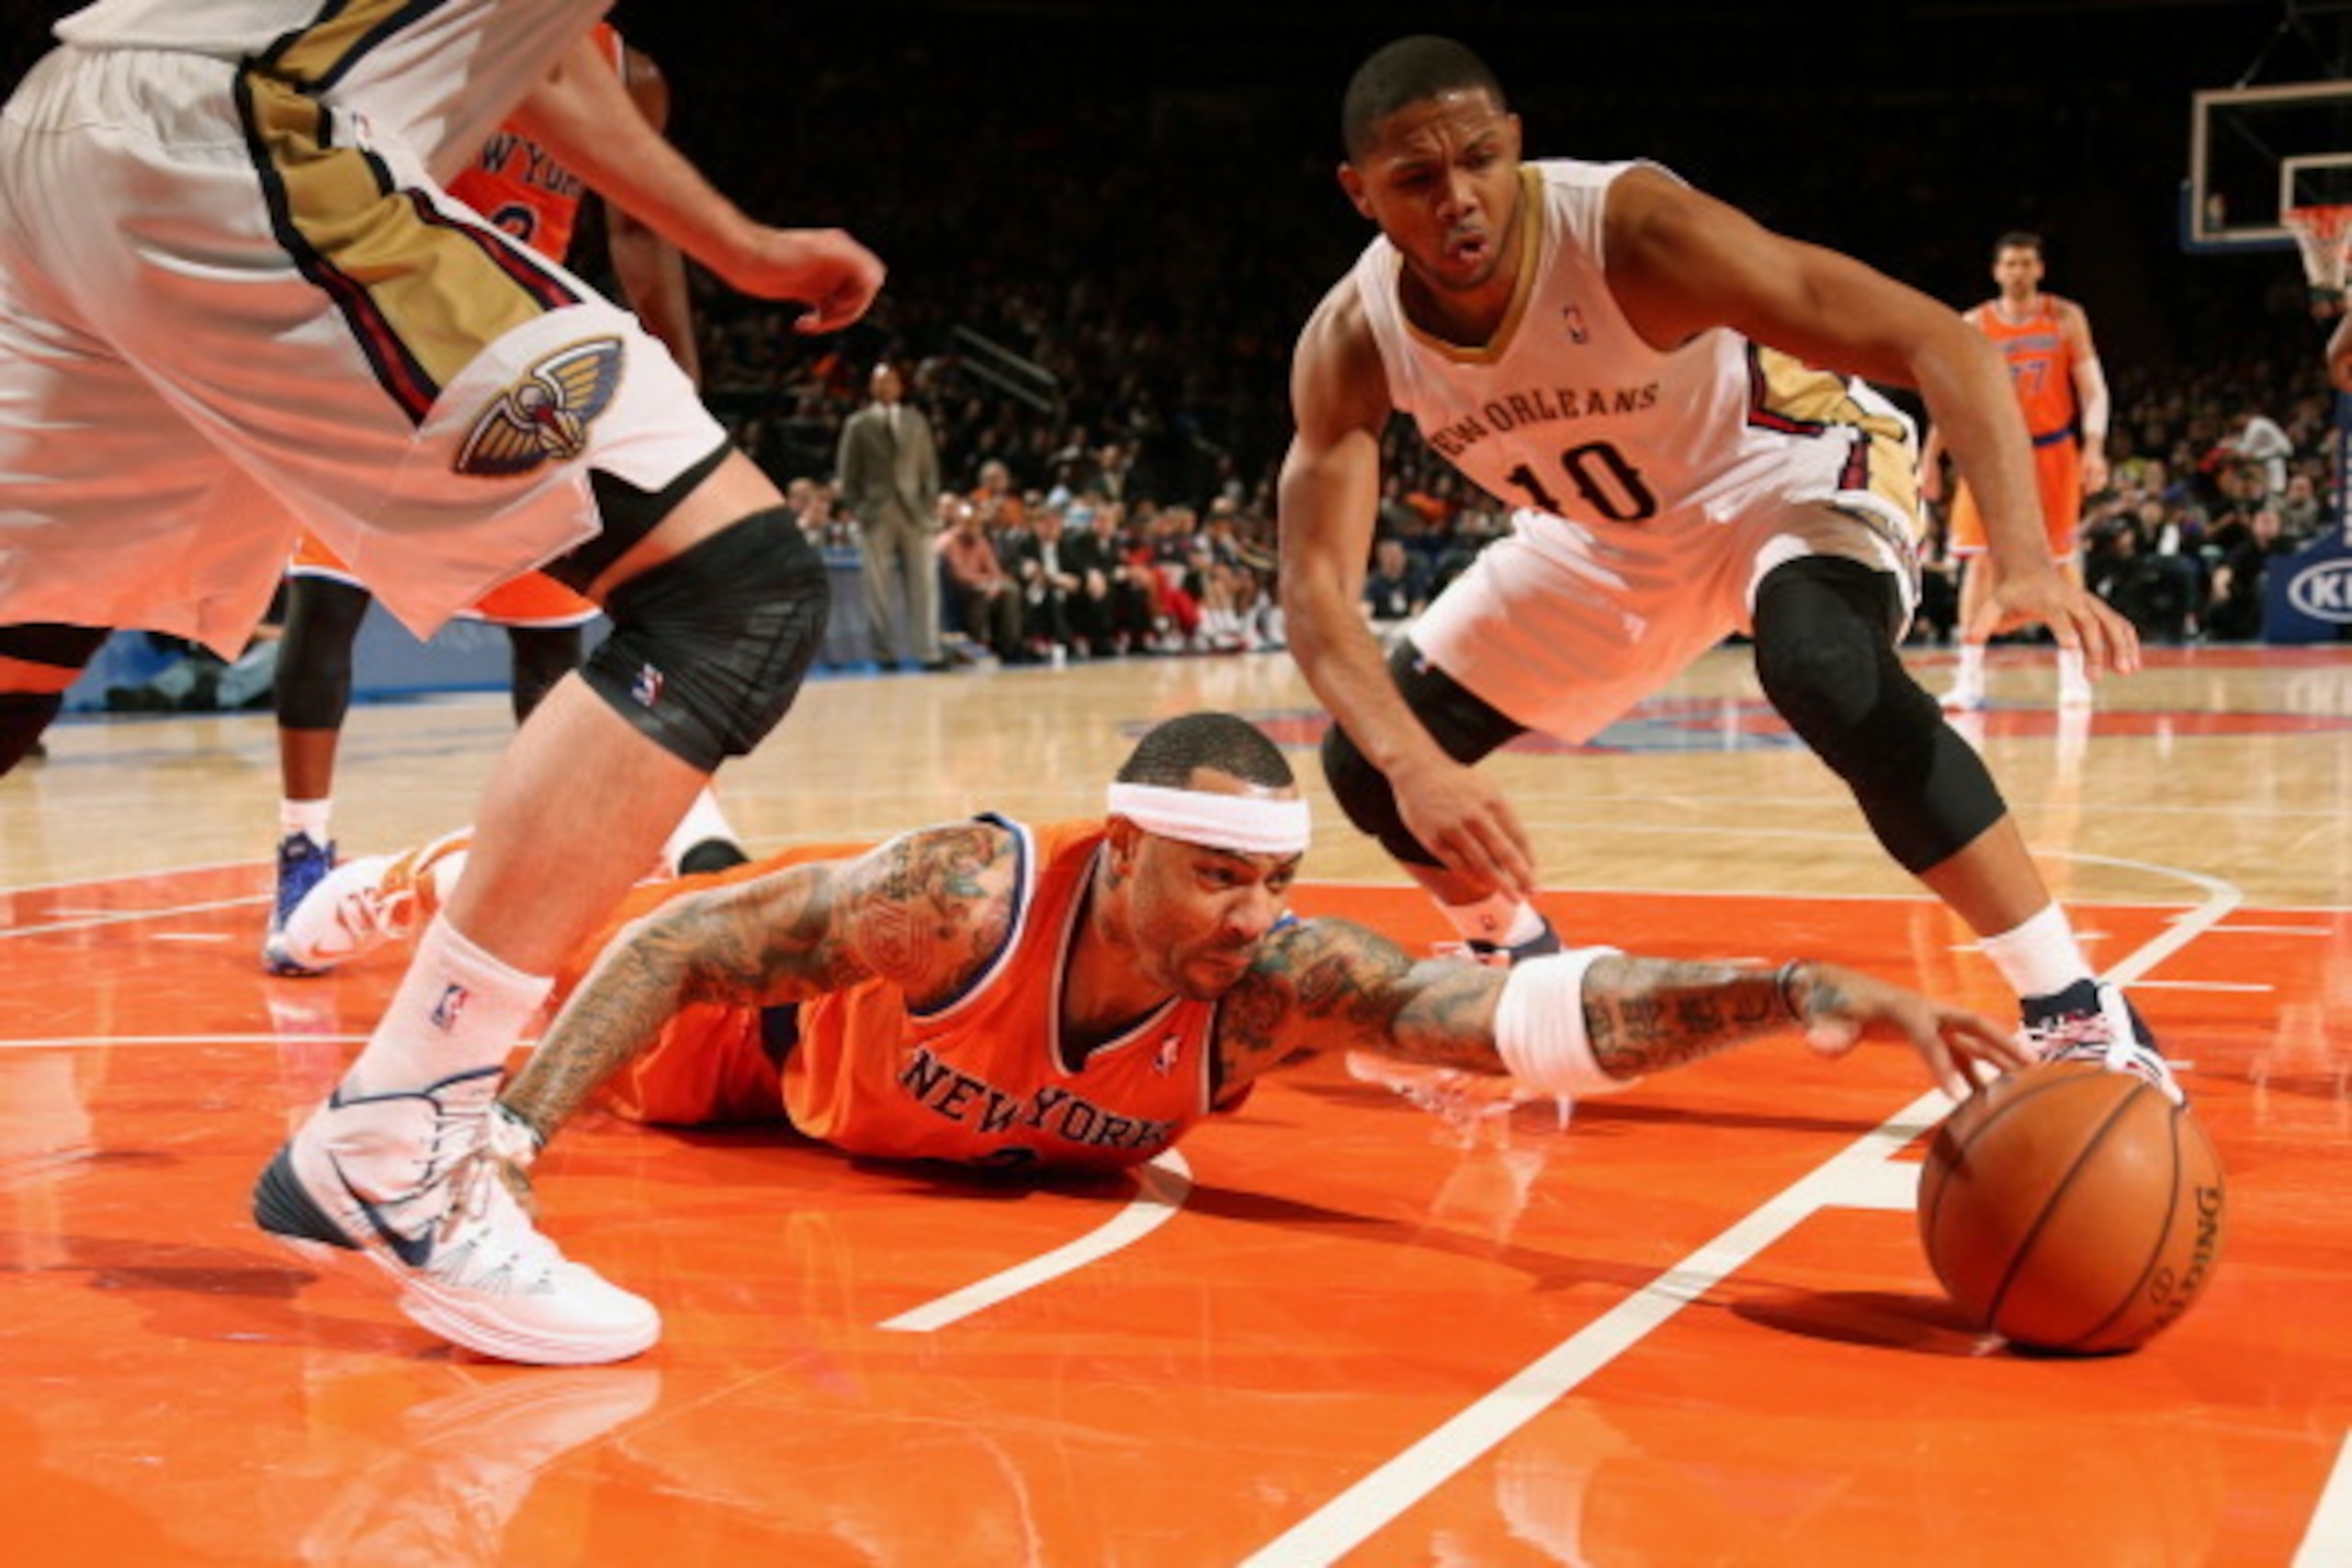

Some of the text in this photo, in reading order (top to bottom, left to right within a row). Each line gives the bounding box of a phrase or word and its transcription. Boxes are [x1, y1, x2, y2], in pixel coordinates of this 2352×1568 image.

[520, 141, 585, 197] YOR
[1483, 383, 1659, 434] ORLEANS
[1505, 440, 1658, 523] 10
[899, 1047, 1180, 1149] NEW YORK
